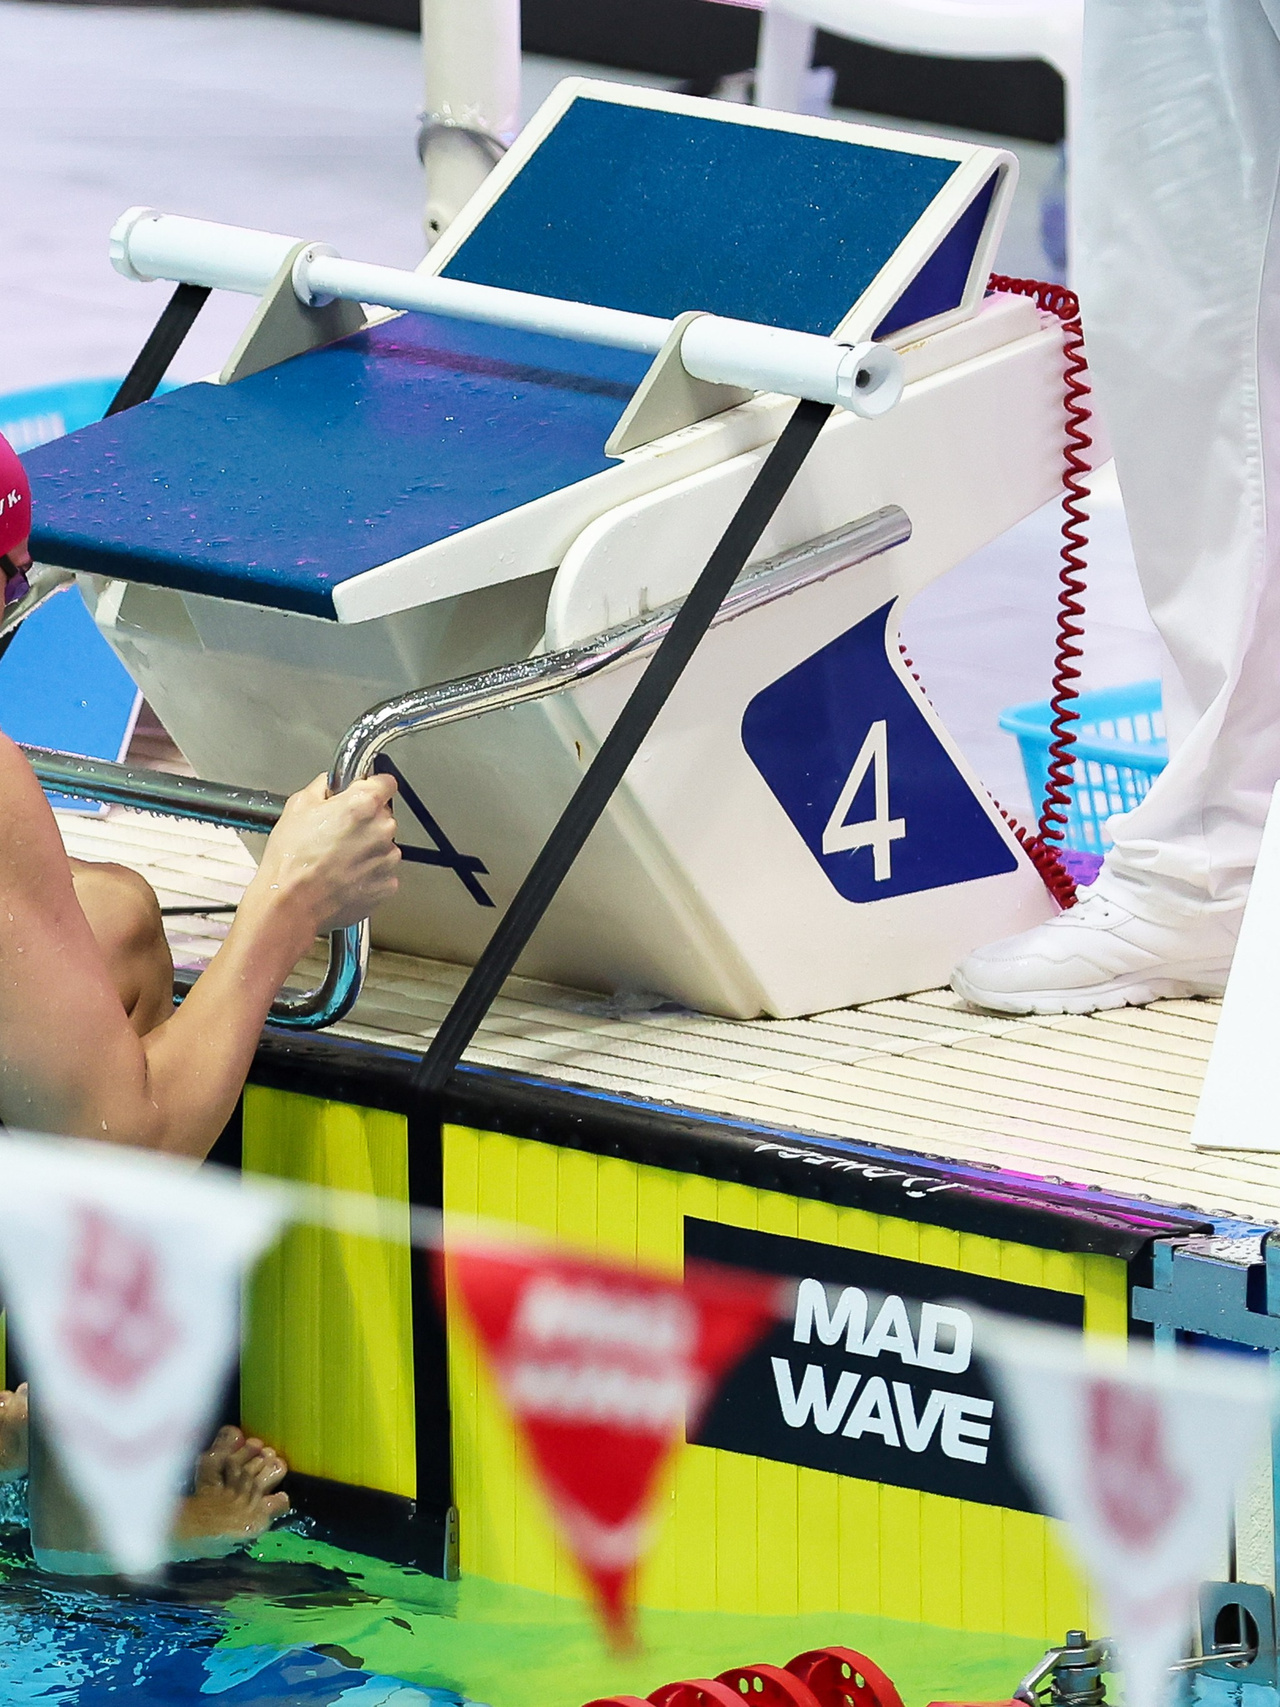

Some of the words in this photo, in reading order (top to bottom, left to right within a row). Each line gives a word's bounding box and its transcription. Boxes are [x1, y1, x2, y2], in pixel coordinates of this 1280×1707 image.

[8, 488, 22, 509] K.
[822, 719, 906, 881] 4
[793, 1277, 974, 1375] MAD
[770, 1355, 995, 1466] WAVE
